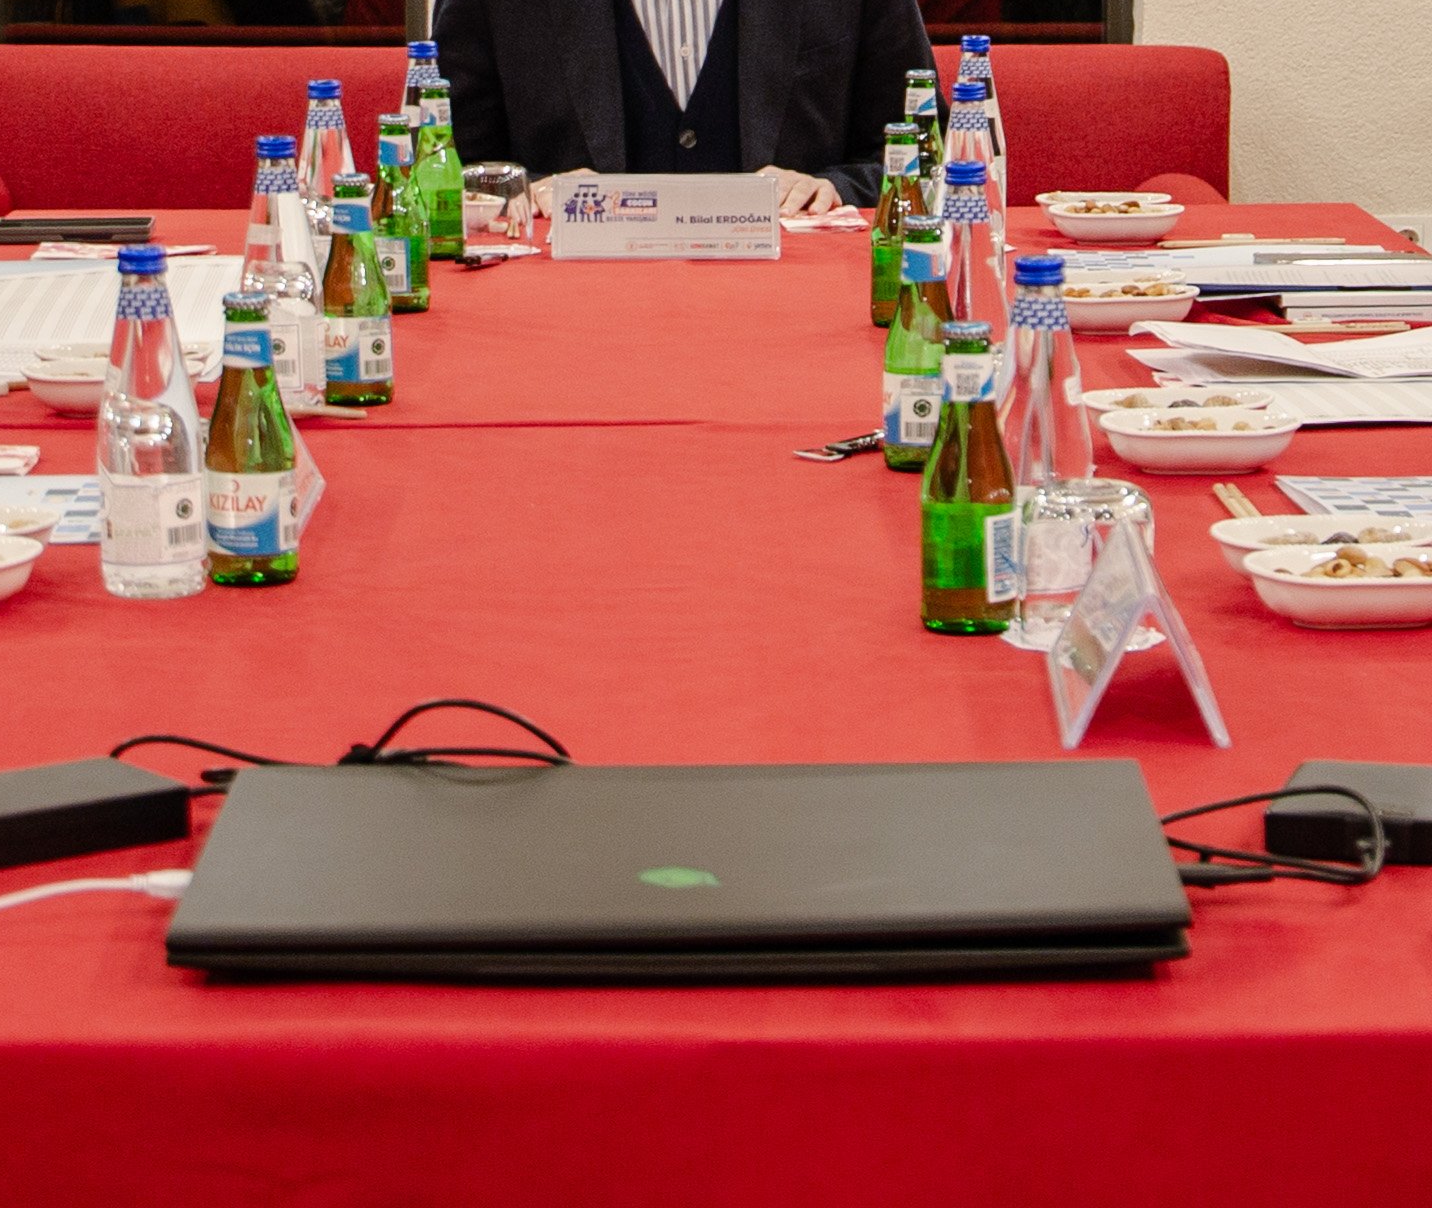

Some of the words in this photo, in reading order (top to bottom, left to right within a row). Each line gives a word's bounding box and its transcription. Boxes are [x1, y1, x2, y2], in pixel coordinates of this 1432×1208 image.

[690, 216, 713, 224] Bilal
[717, 213, 772, 224] ERDOĞAN
[209, 494, 267, 513] KIZILAY
